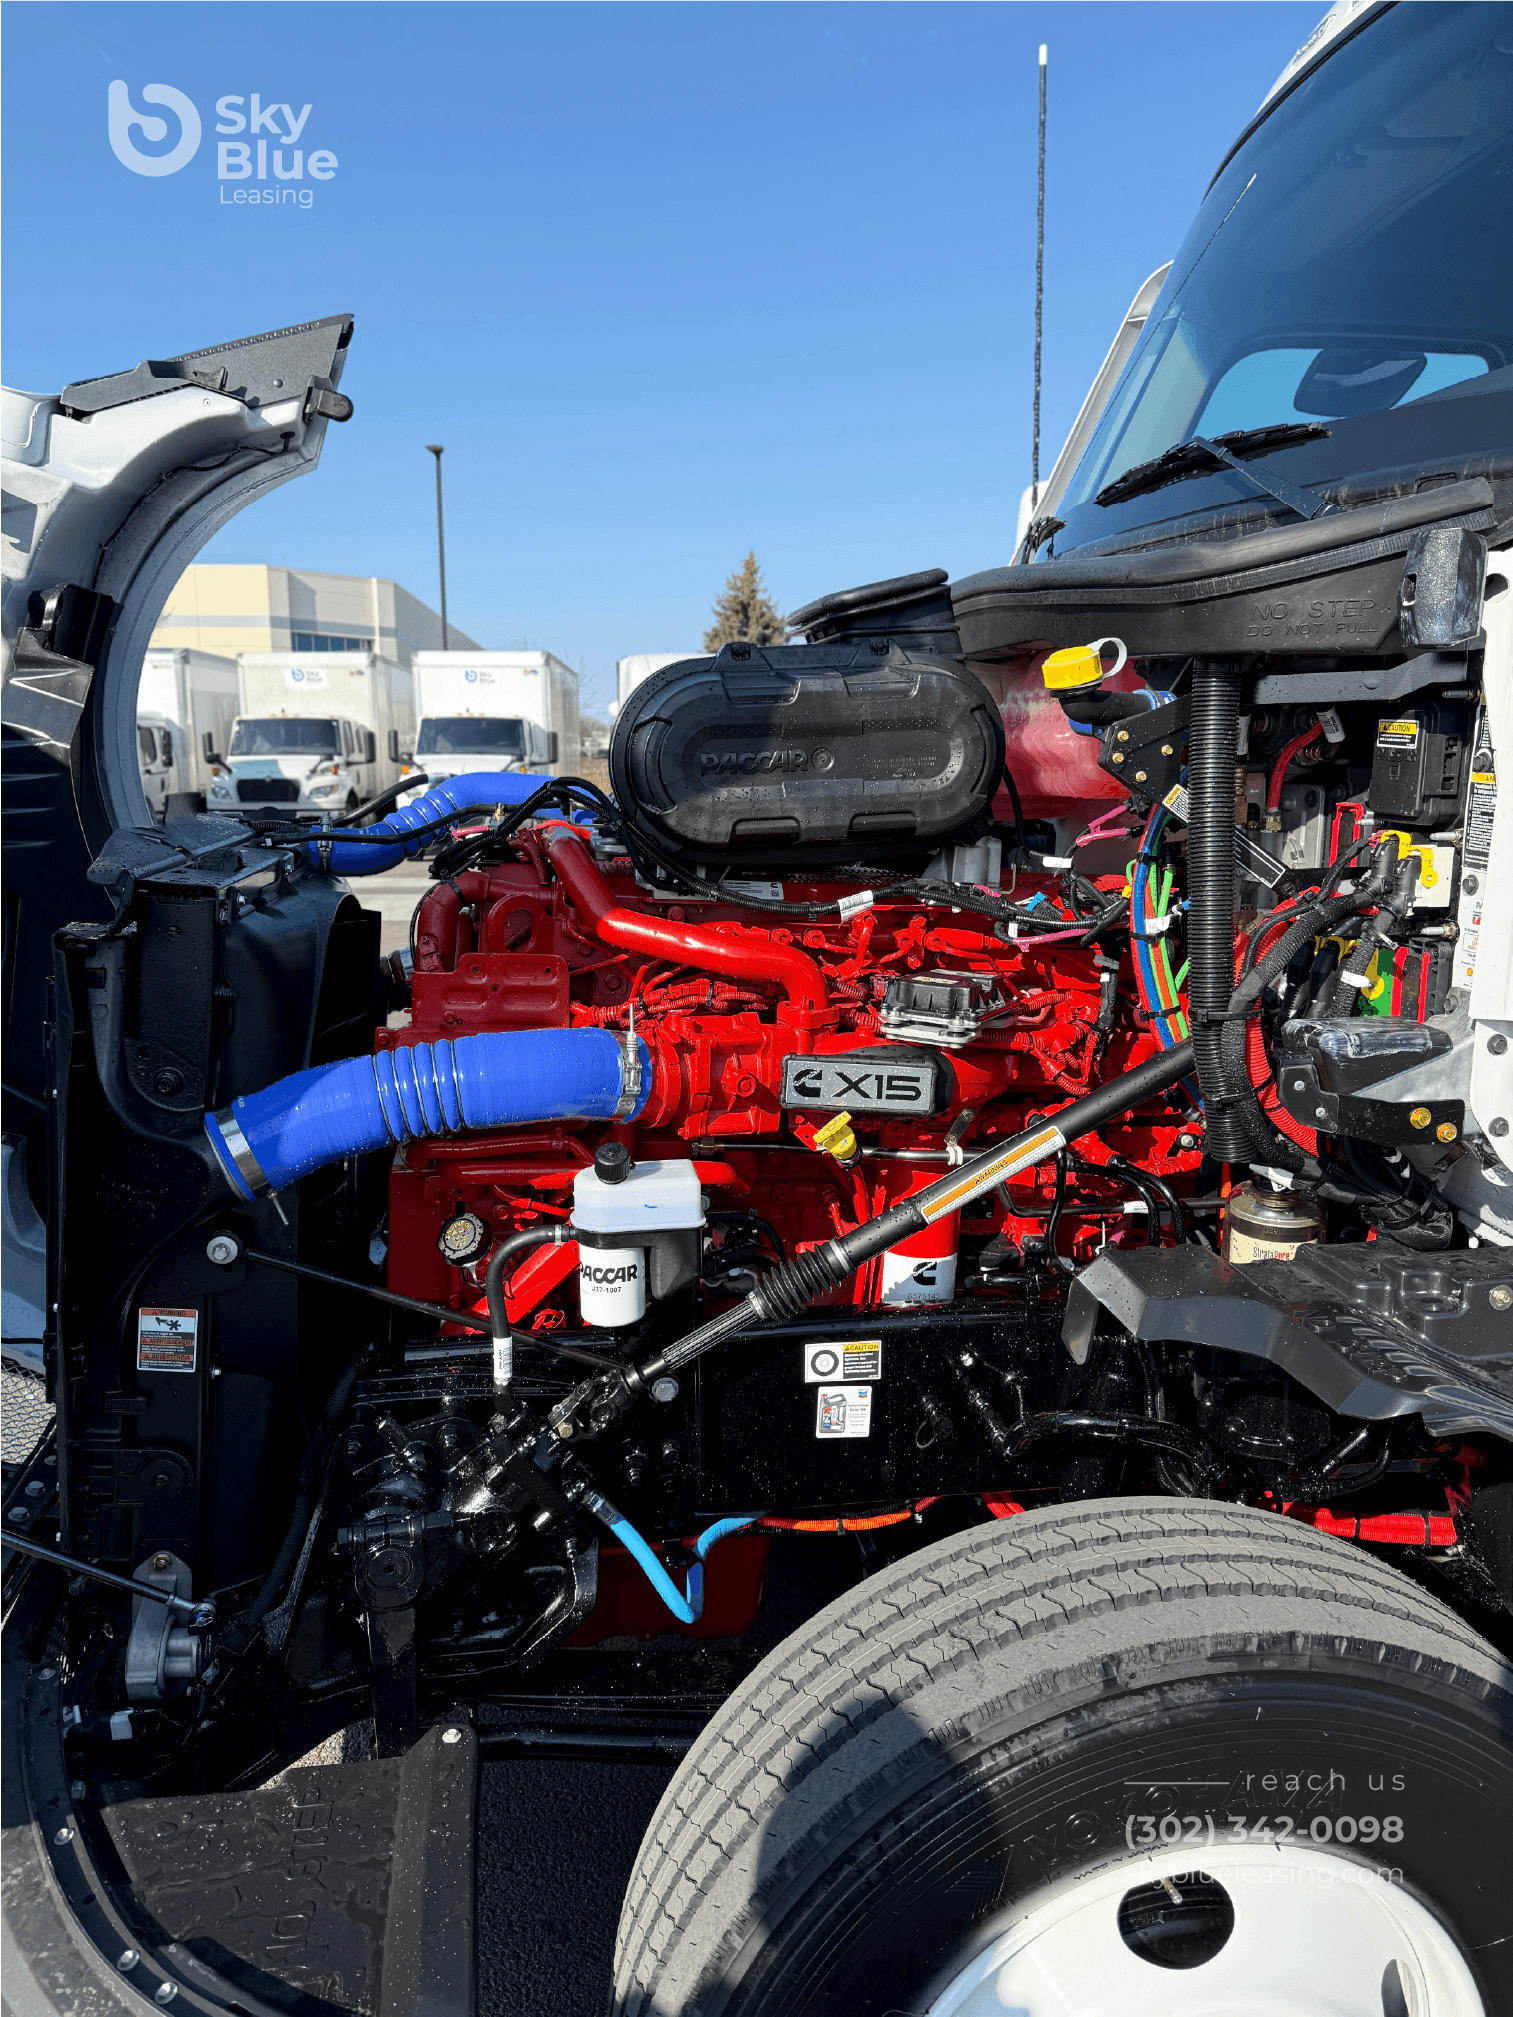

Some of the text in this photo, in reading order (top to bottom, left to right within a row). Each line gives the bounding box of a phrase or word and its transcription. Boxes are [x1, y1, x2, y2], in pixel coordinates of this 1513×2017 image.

[1250, 599, 1376, 621] NO STEP
[1247, 621, 1378, 637] DO NOT PULL
[700, 748, 808, 776] PACCAR
[831, 1071, 922, 1102] X15
[978, 1159, 1008, 1182] WARNING
[591, 1286, 622, 1294] J37-1007
